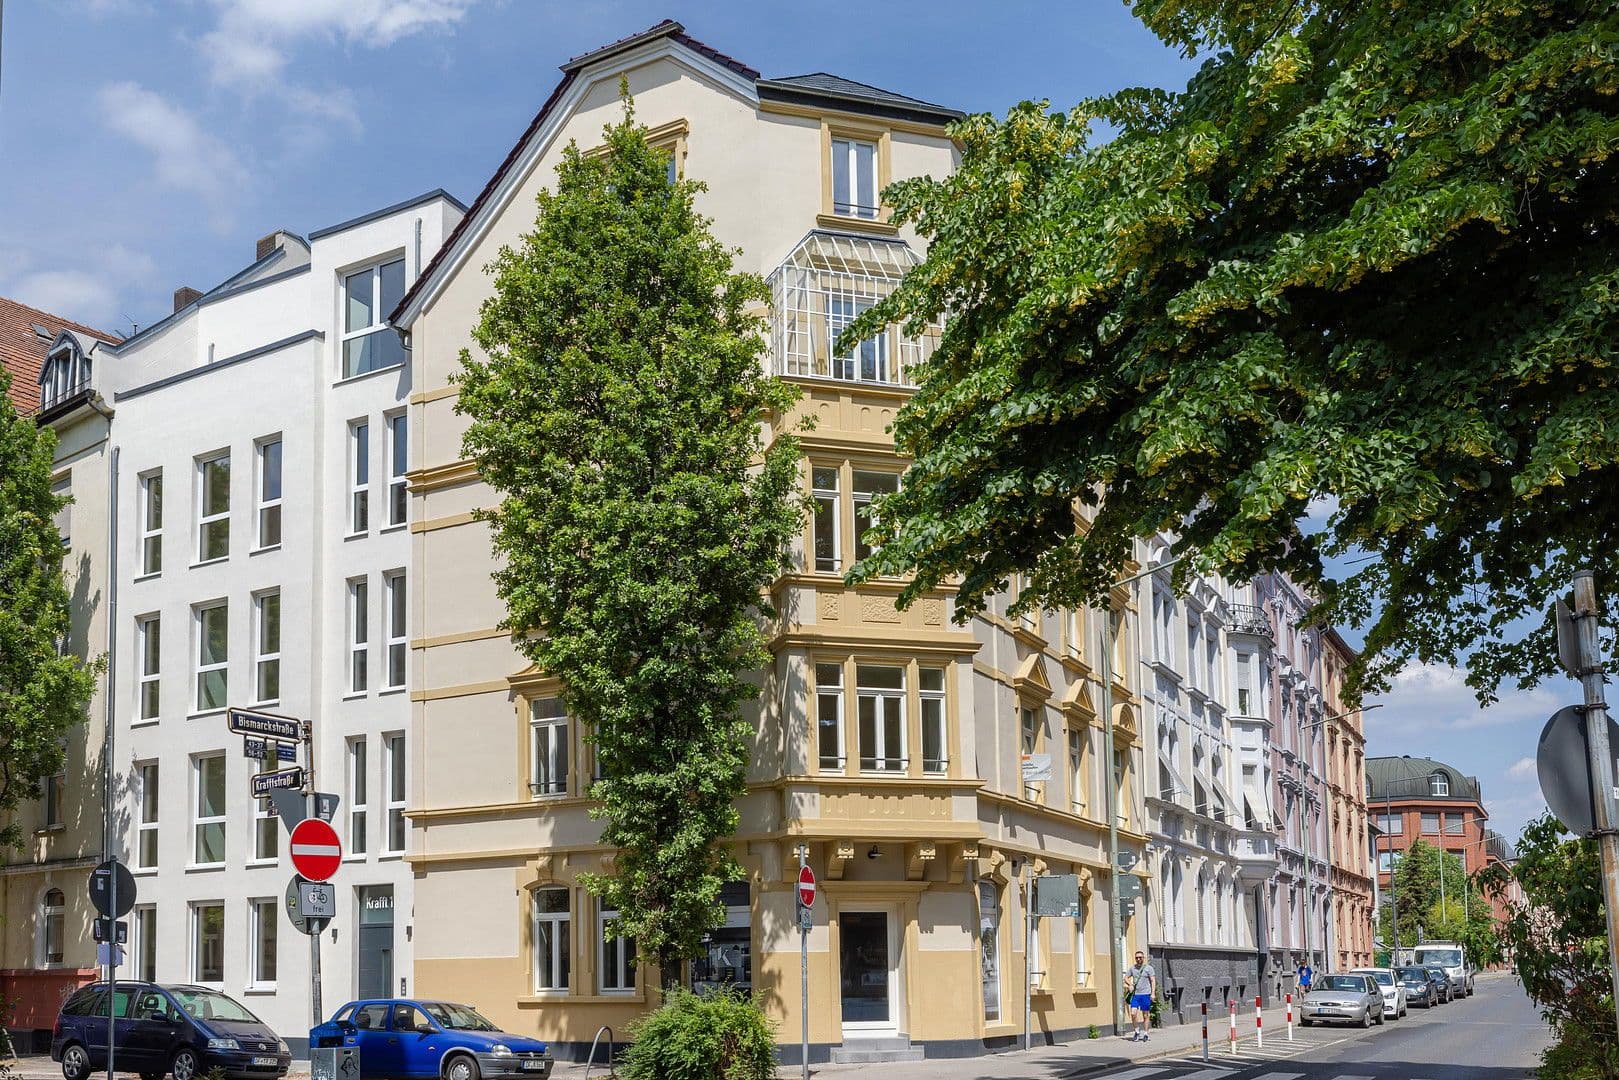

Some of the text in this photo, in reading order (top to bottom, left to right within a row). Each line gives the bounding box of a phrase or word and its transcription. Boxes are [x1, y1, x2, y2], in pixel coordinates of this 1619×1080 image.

[238, 716, 294, 735] Bismarckstraße
[312, 905, 325, 913] frei
[366, 896, 388, 909] Krafft
